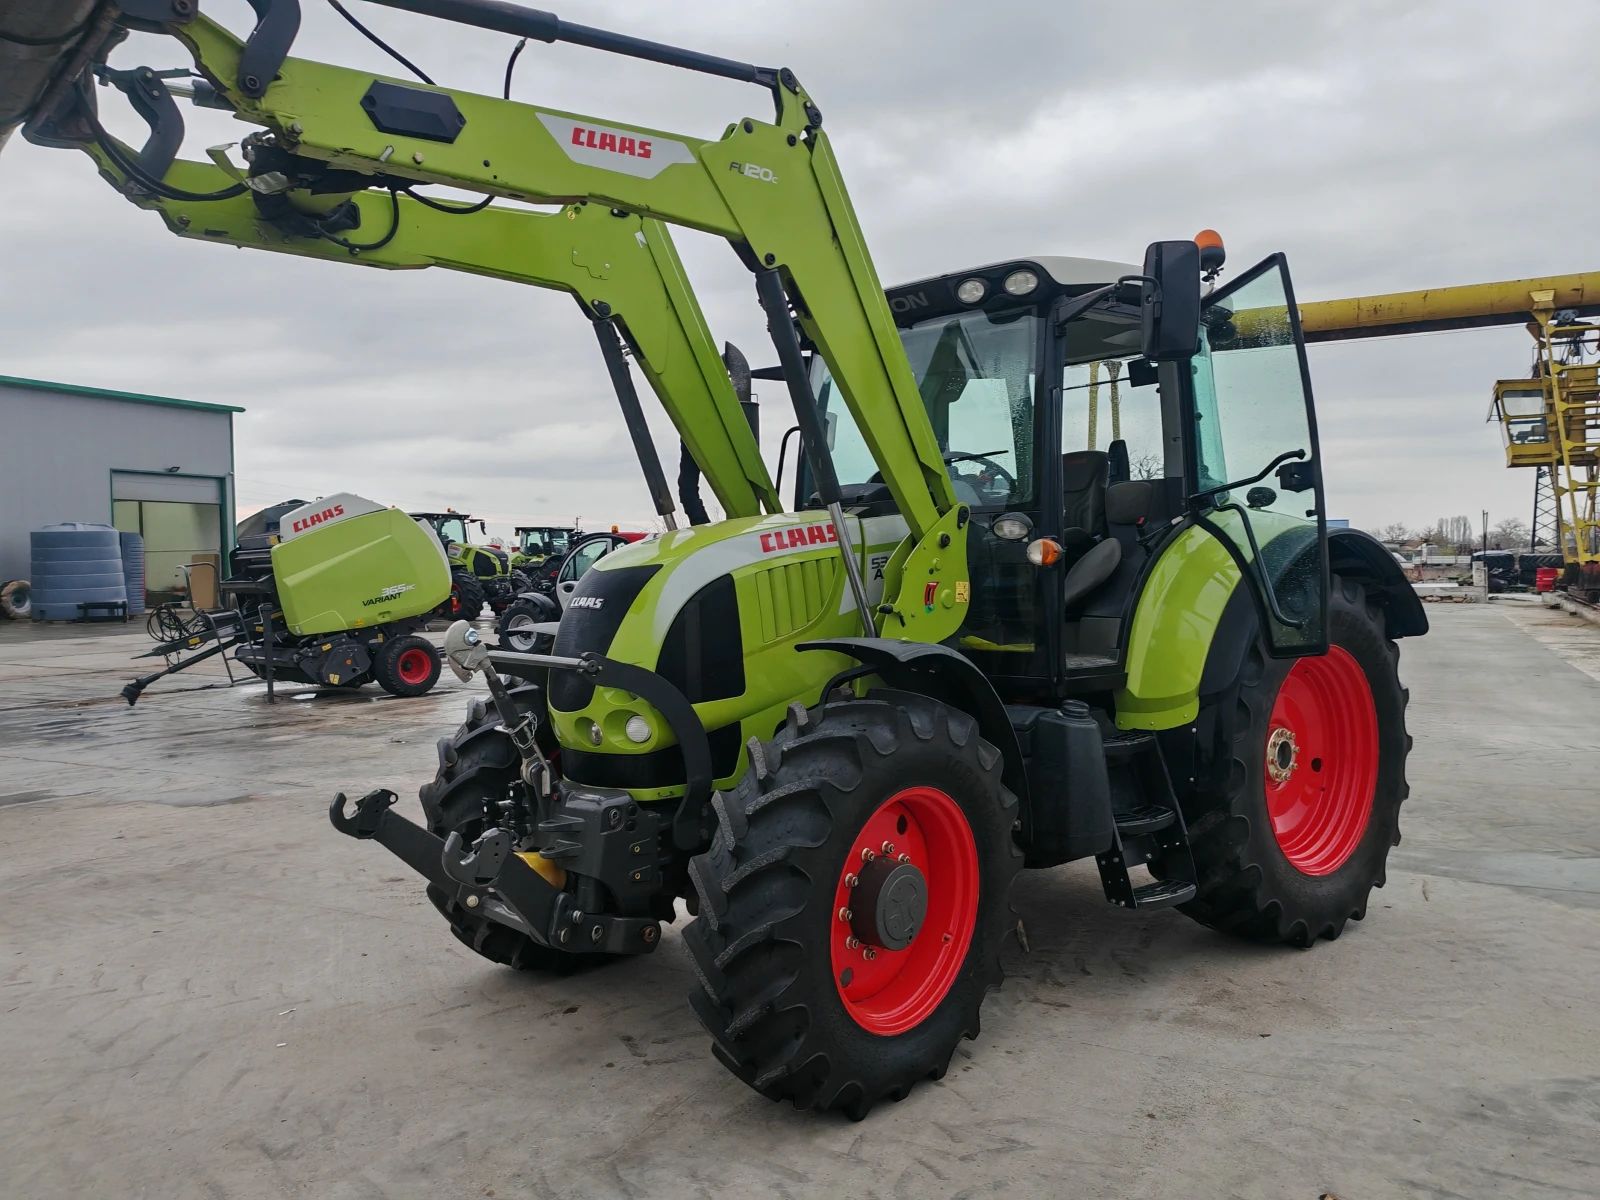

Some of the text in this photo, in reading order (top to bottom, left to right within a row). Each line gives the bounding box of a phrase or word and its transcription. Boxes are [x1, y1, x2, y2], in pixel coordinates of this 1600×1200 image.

[571, 127, 652, 159] CLAAS
[889, 292, 929, 313] ON
[293, 504, 344, 533] CLAAS
[871, 556, 889, 570] 53
[362, 592, 402, 607] VARIANT
[570, 597, 603, 609] CLAAS
